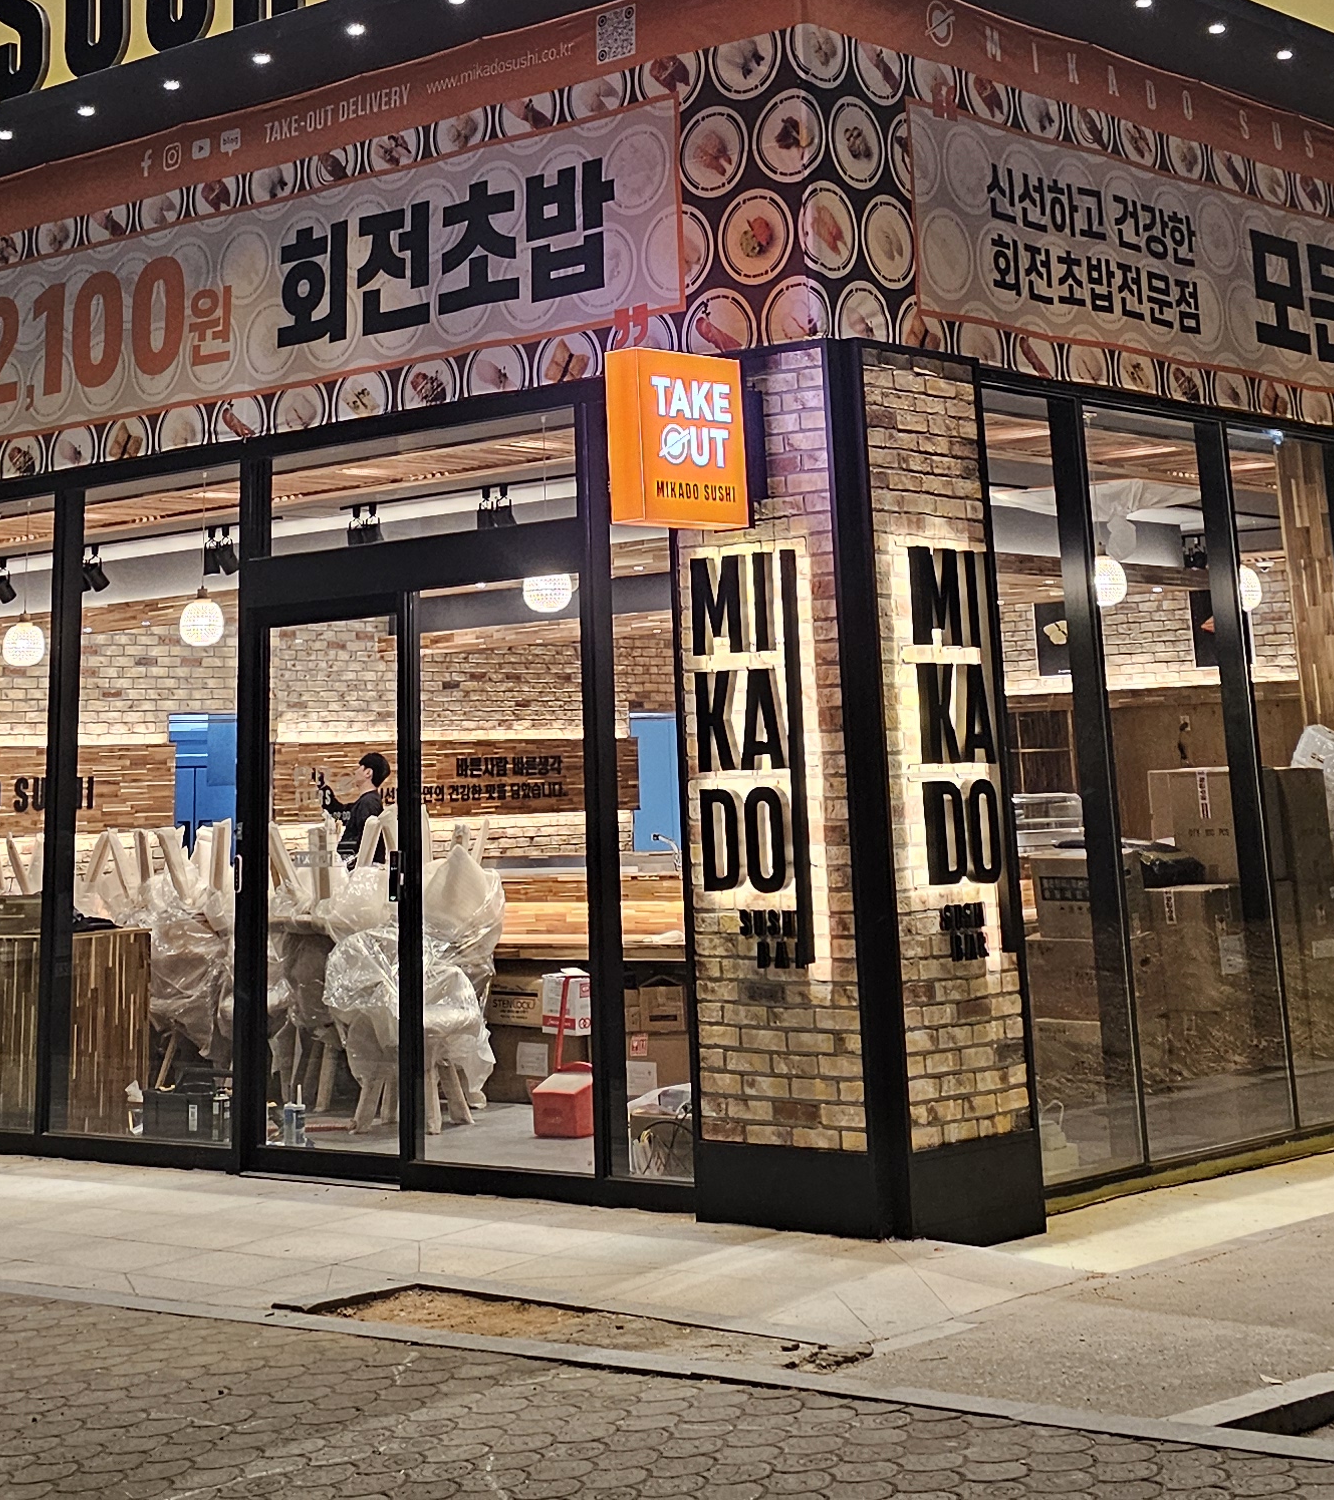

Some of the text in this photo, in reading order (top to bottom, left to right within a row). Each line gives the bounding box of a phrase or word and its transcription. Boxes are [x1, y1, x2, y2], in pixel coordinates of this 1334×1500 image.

[264, 41, 575, 145] TAKE-OUT DELIVERY www.mikadosushi.co.kr
[985, 26, 1195, 121] MIKADO
[277, 157, 616, 349] 회전초밥
[988, 163, 1197, 269] 신선하고 건강한
[990, 232, 1203, 337] 회전초밥전문점
[651, 376, 733, 423] TAKE
[659, 423, 729, 468] OUT
[656, 480, 736, 502] MIKADO SUSHI
[909, 547, 982, 656] MI
[694, 668, 788, 772] KA
[916, 662, 996, 766] KA
[421, 785, 445, 805] 연의
[447, 783, 482, 803] 건강한
[699, 785, 793, 892] DO
[922, 779, 1002, 886] DO
[739, 910, 798, 936] SUSH
